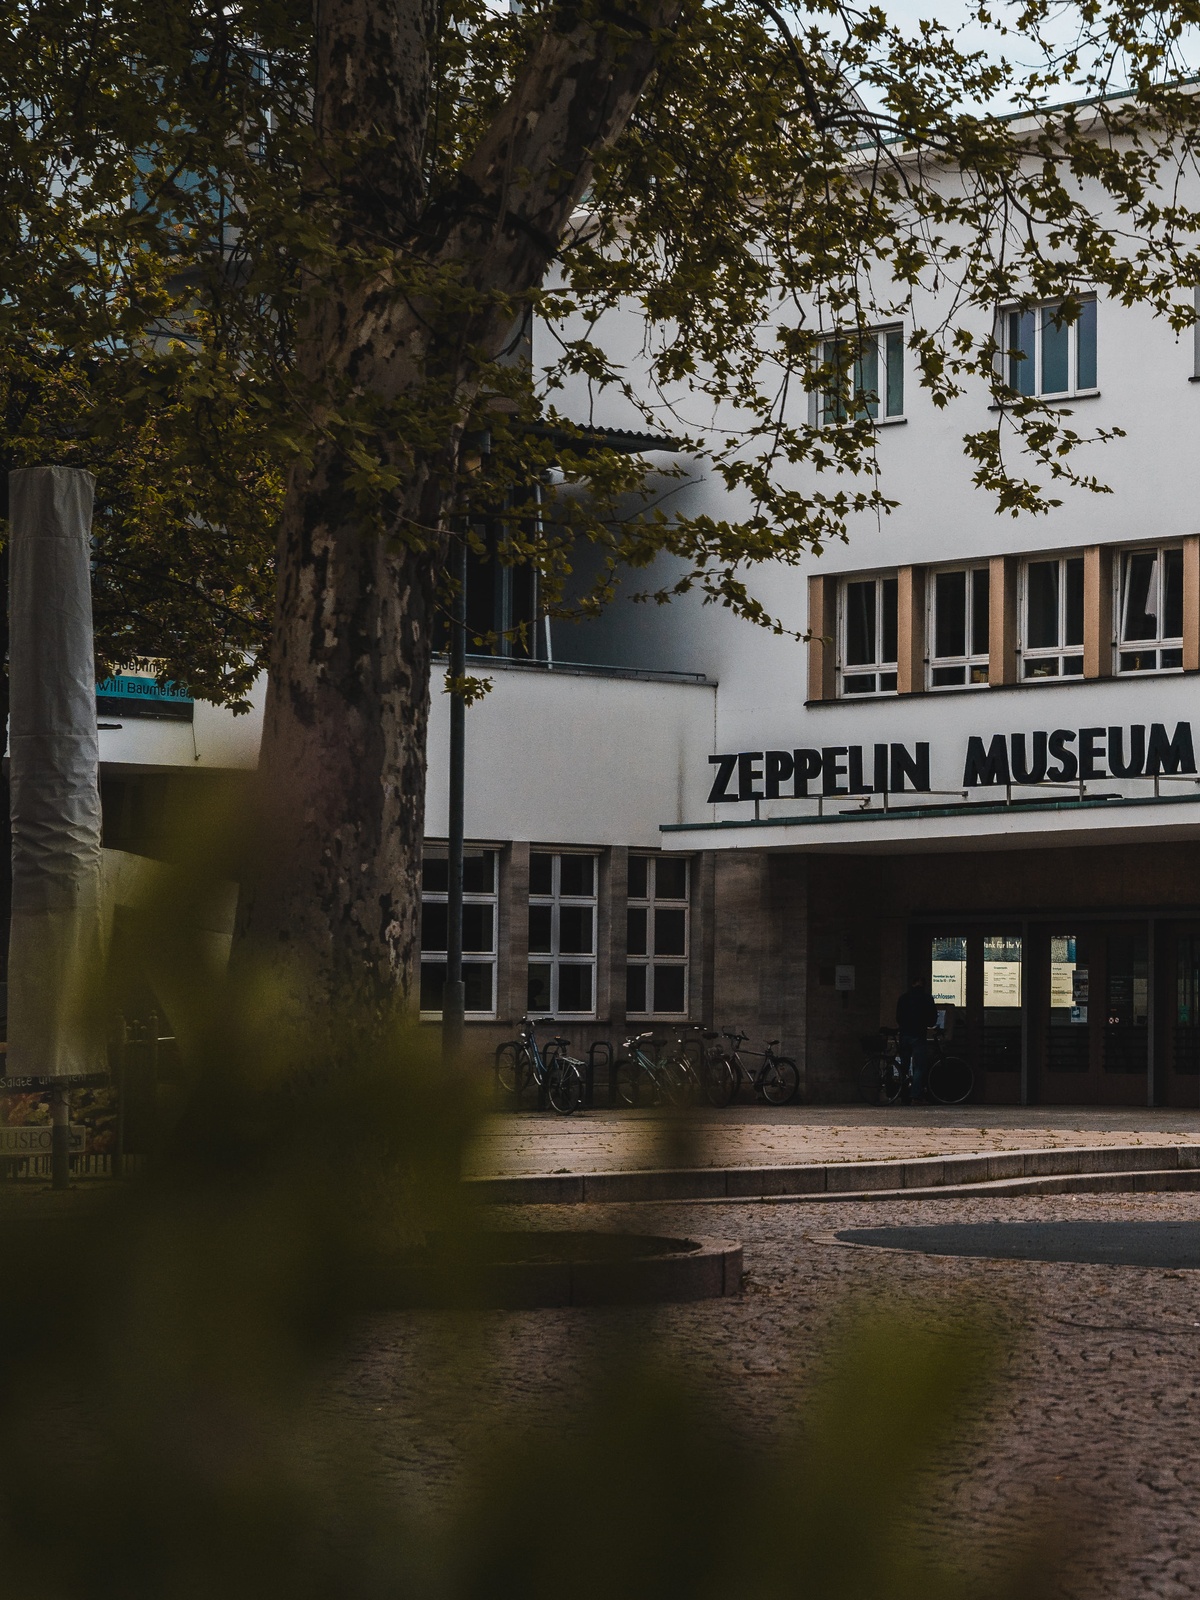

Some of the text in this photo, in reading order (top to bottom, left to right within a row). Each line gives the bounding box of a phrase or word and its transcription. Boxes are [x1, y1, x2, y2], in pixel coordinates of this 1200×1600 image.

[127, 682, 192, 700] Baumeiste
[706, 721, 1198, 804] ZEPPELIN MUSEUM
[984, 941, 996, 949] ank
[0, 1076, 33, 1089] Salate
